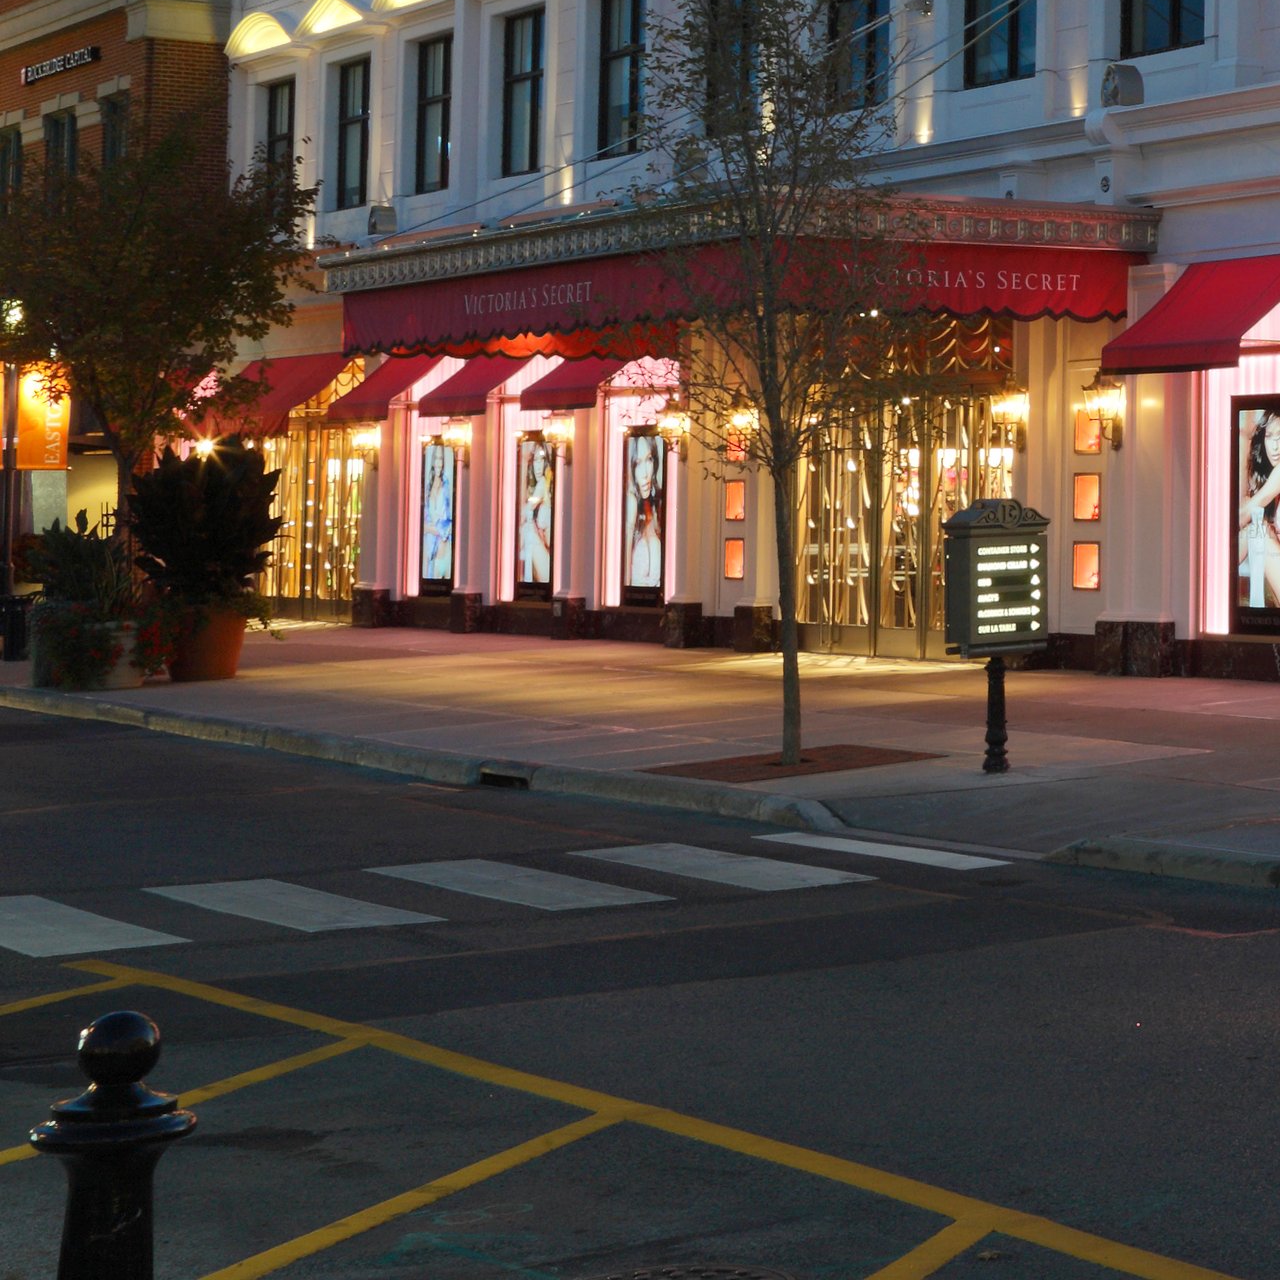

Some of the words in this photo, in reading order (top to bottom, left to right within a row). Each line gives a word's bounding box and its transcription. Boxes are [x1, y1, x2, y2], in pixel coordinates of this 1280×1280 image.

[997, 270, 1081, 292] SECRET
[463, 287, 538, 315] VICTORIA'S
[542, 280, 593, 306] SECRET
